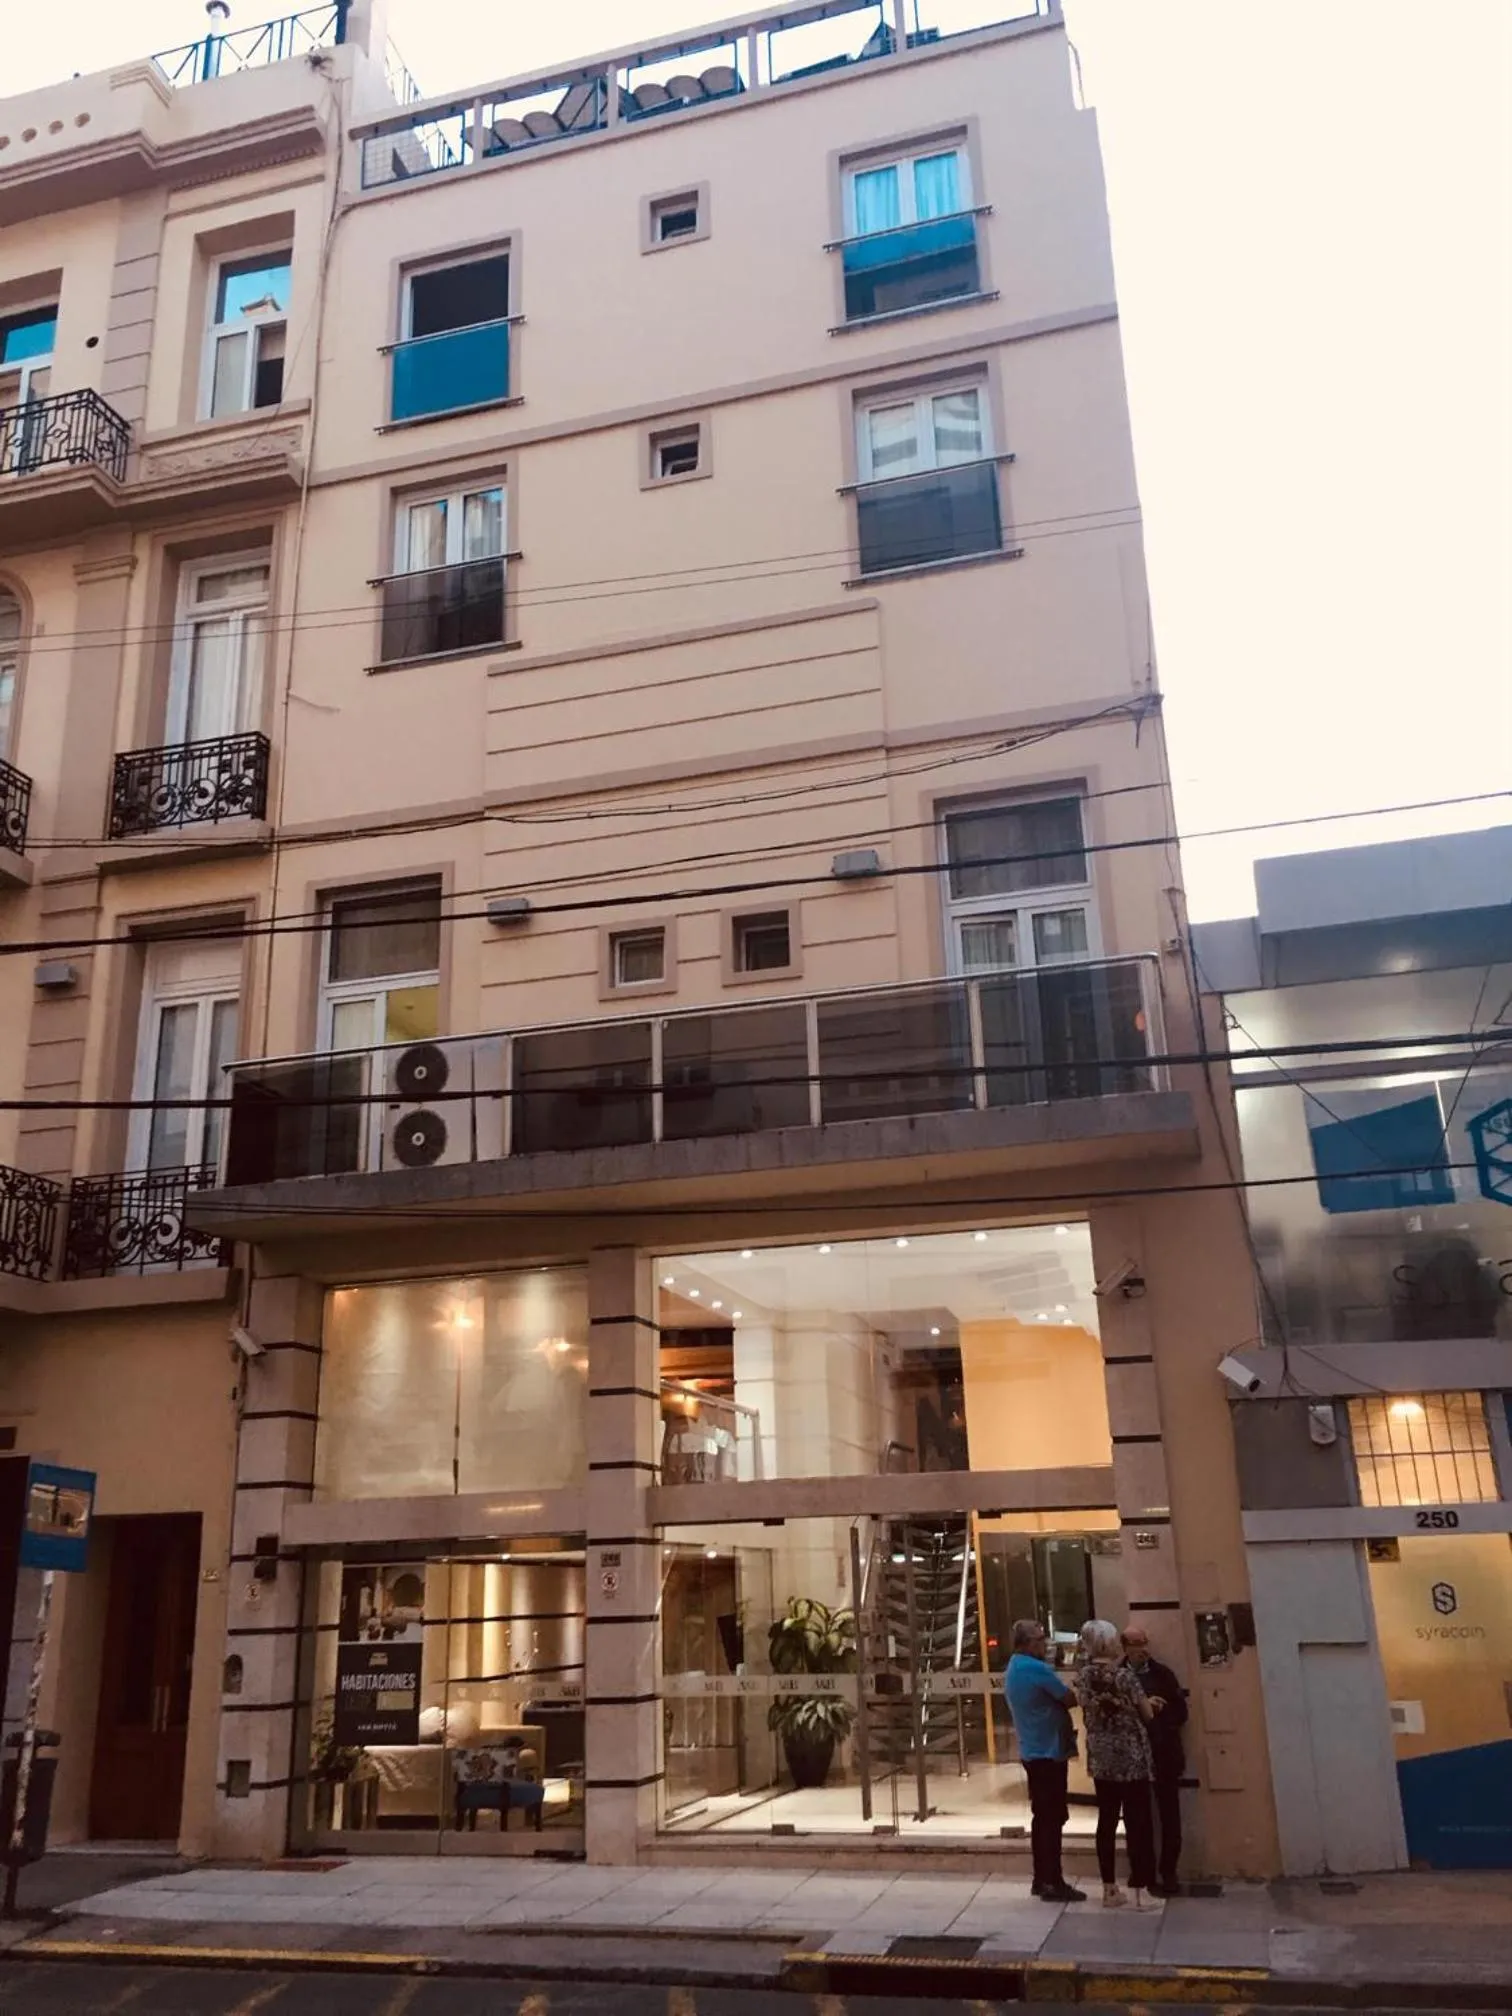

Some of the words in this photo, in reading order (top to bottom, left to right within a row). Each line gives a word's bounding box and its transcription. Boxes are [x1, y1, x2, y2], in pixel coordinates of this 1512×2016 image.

[1416, 1510, 1459, 1528] 250
[1415, 1625, 1486, 1641] syracoin
[341, 1673, 416, 1690] HABITACIONES
